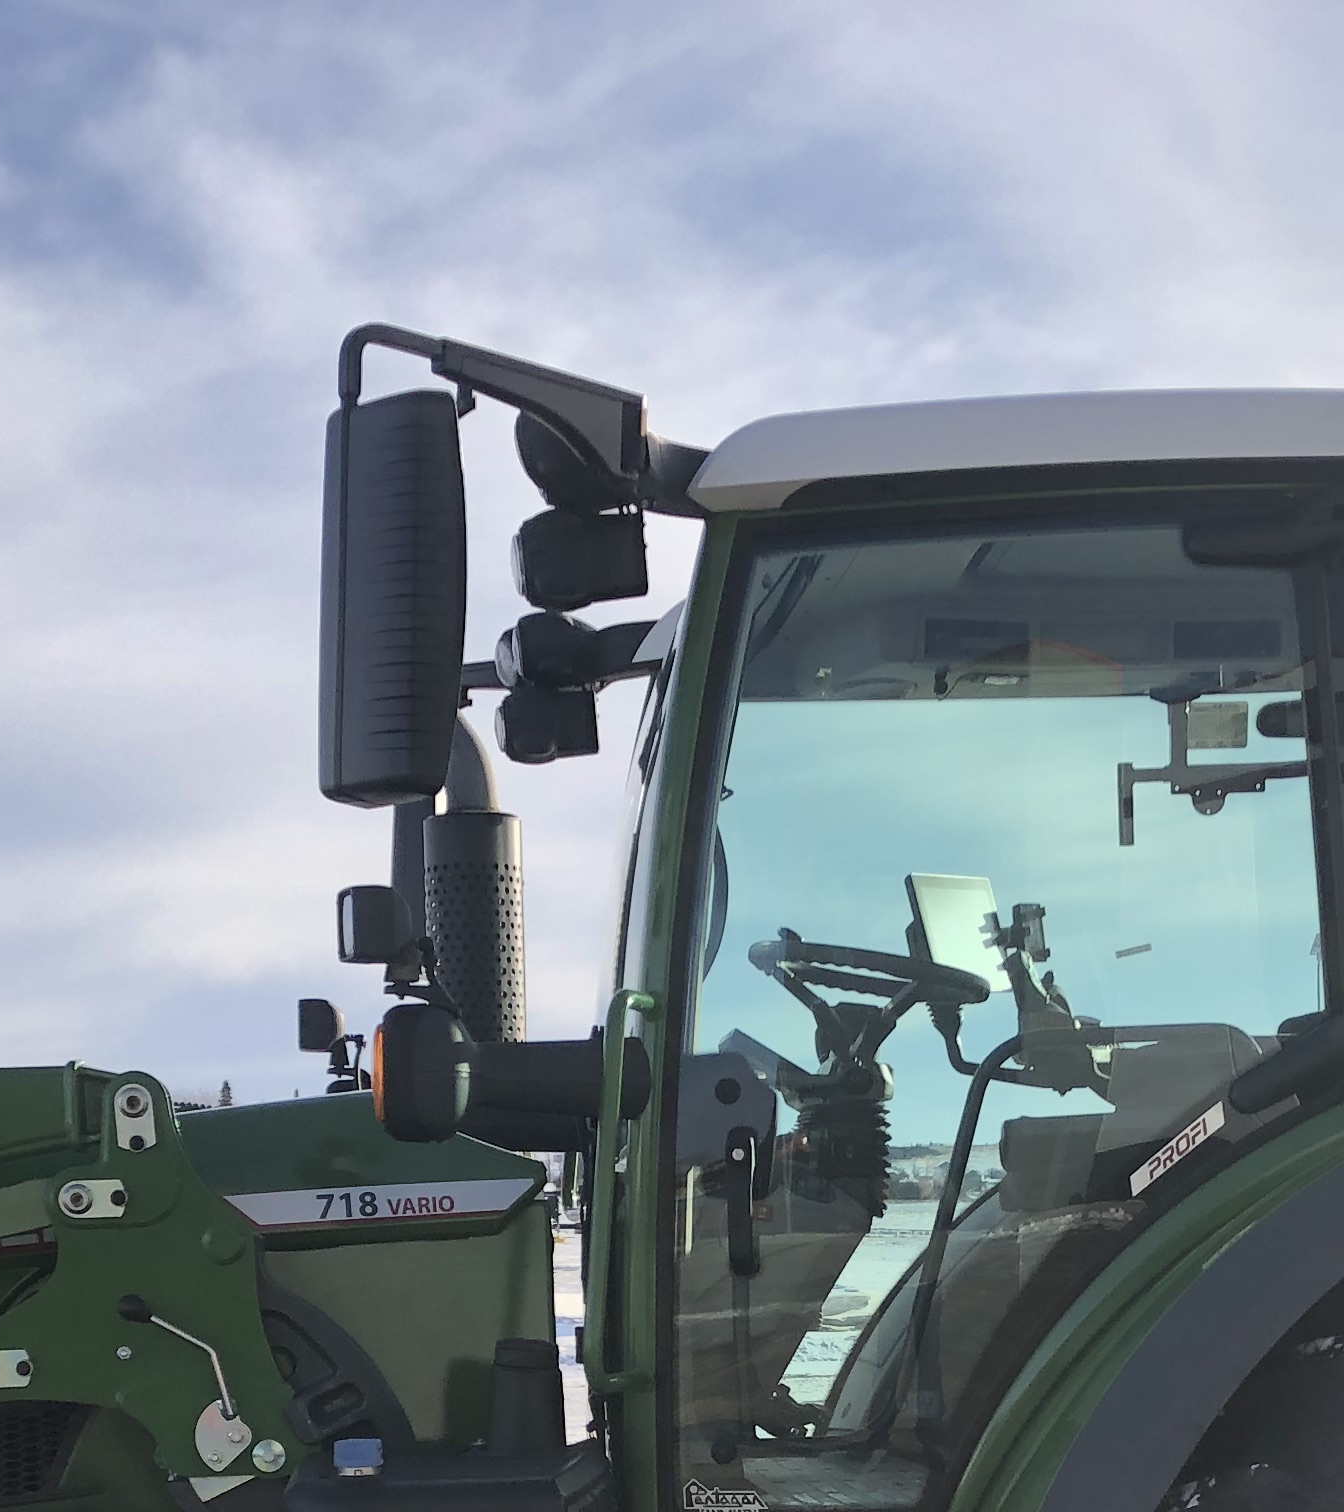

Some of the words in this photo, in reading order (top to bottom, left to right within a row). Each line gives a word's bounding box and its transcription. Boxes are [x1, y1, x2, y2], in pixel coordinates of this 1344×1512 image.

[1147, 1117, 1208, 1181] PROFI
[315, 1189, 378, 1221] 718
[387, 1194, 456, 1217] VARIO
